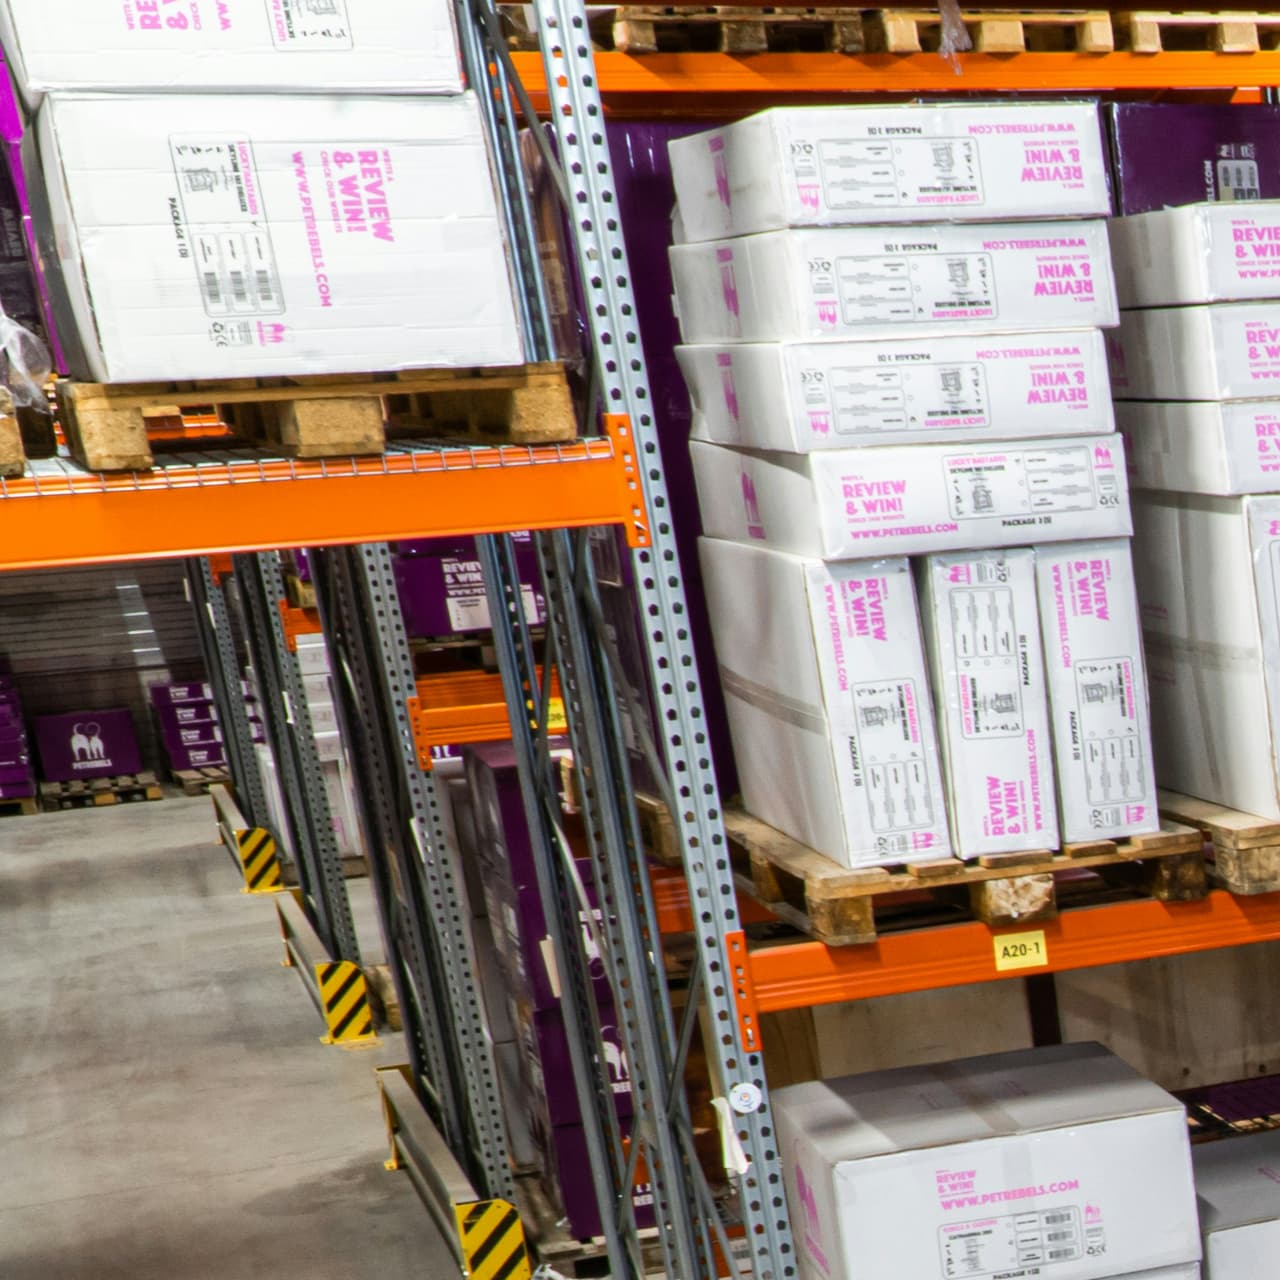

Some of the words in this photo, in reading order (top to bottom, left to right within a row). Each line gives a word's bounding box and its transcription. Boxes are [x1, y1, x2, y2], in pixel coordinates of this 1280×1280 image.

[333, 151, 354, 168] &
[337, 176, 367, 233] WIN!
[357, 150, 395, 242] REVIEW
[168, 198, 185, 240] PACKAGE
[292, 152, 332, 307] WWW.PETREBELS.COM
[1236, 246, 1247, 258] &
[1248, 347, 1260, 360] &
[1258, 440, 1269, 452] &
[843, 480, 906, 498] REVIEW
[845, 499, 856, 515] &
[858, 497, 902, 514] WIN!
[850, 522, 959, 540] WWW.PETREBELS.COM
[443, 561, 482, 573] REVIE
[1074, 562, 1088, 573] &
[849, 580, 862, 592] &
[1089, 560, 1110, 621] REVIEW
[1077, 577, 1093, 616] WIN!
[851, 596, 870, 637] WIN!
[865, 579, 887, 642] REVIEW
[986, 776, 1004, 836] REVIEW
[1004, 781, 1019, 819] WIN!
[1008, 824, 1021, 834] &
[1001, 941, 1041, 959] A20-1
[936, 1170, 976, 1185] REVIEW
[941, 1180, 1079, 1210] WWW.PETREBELS.COM
